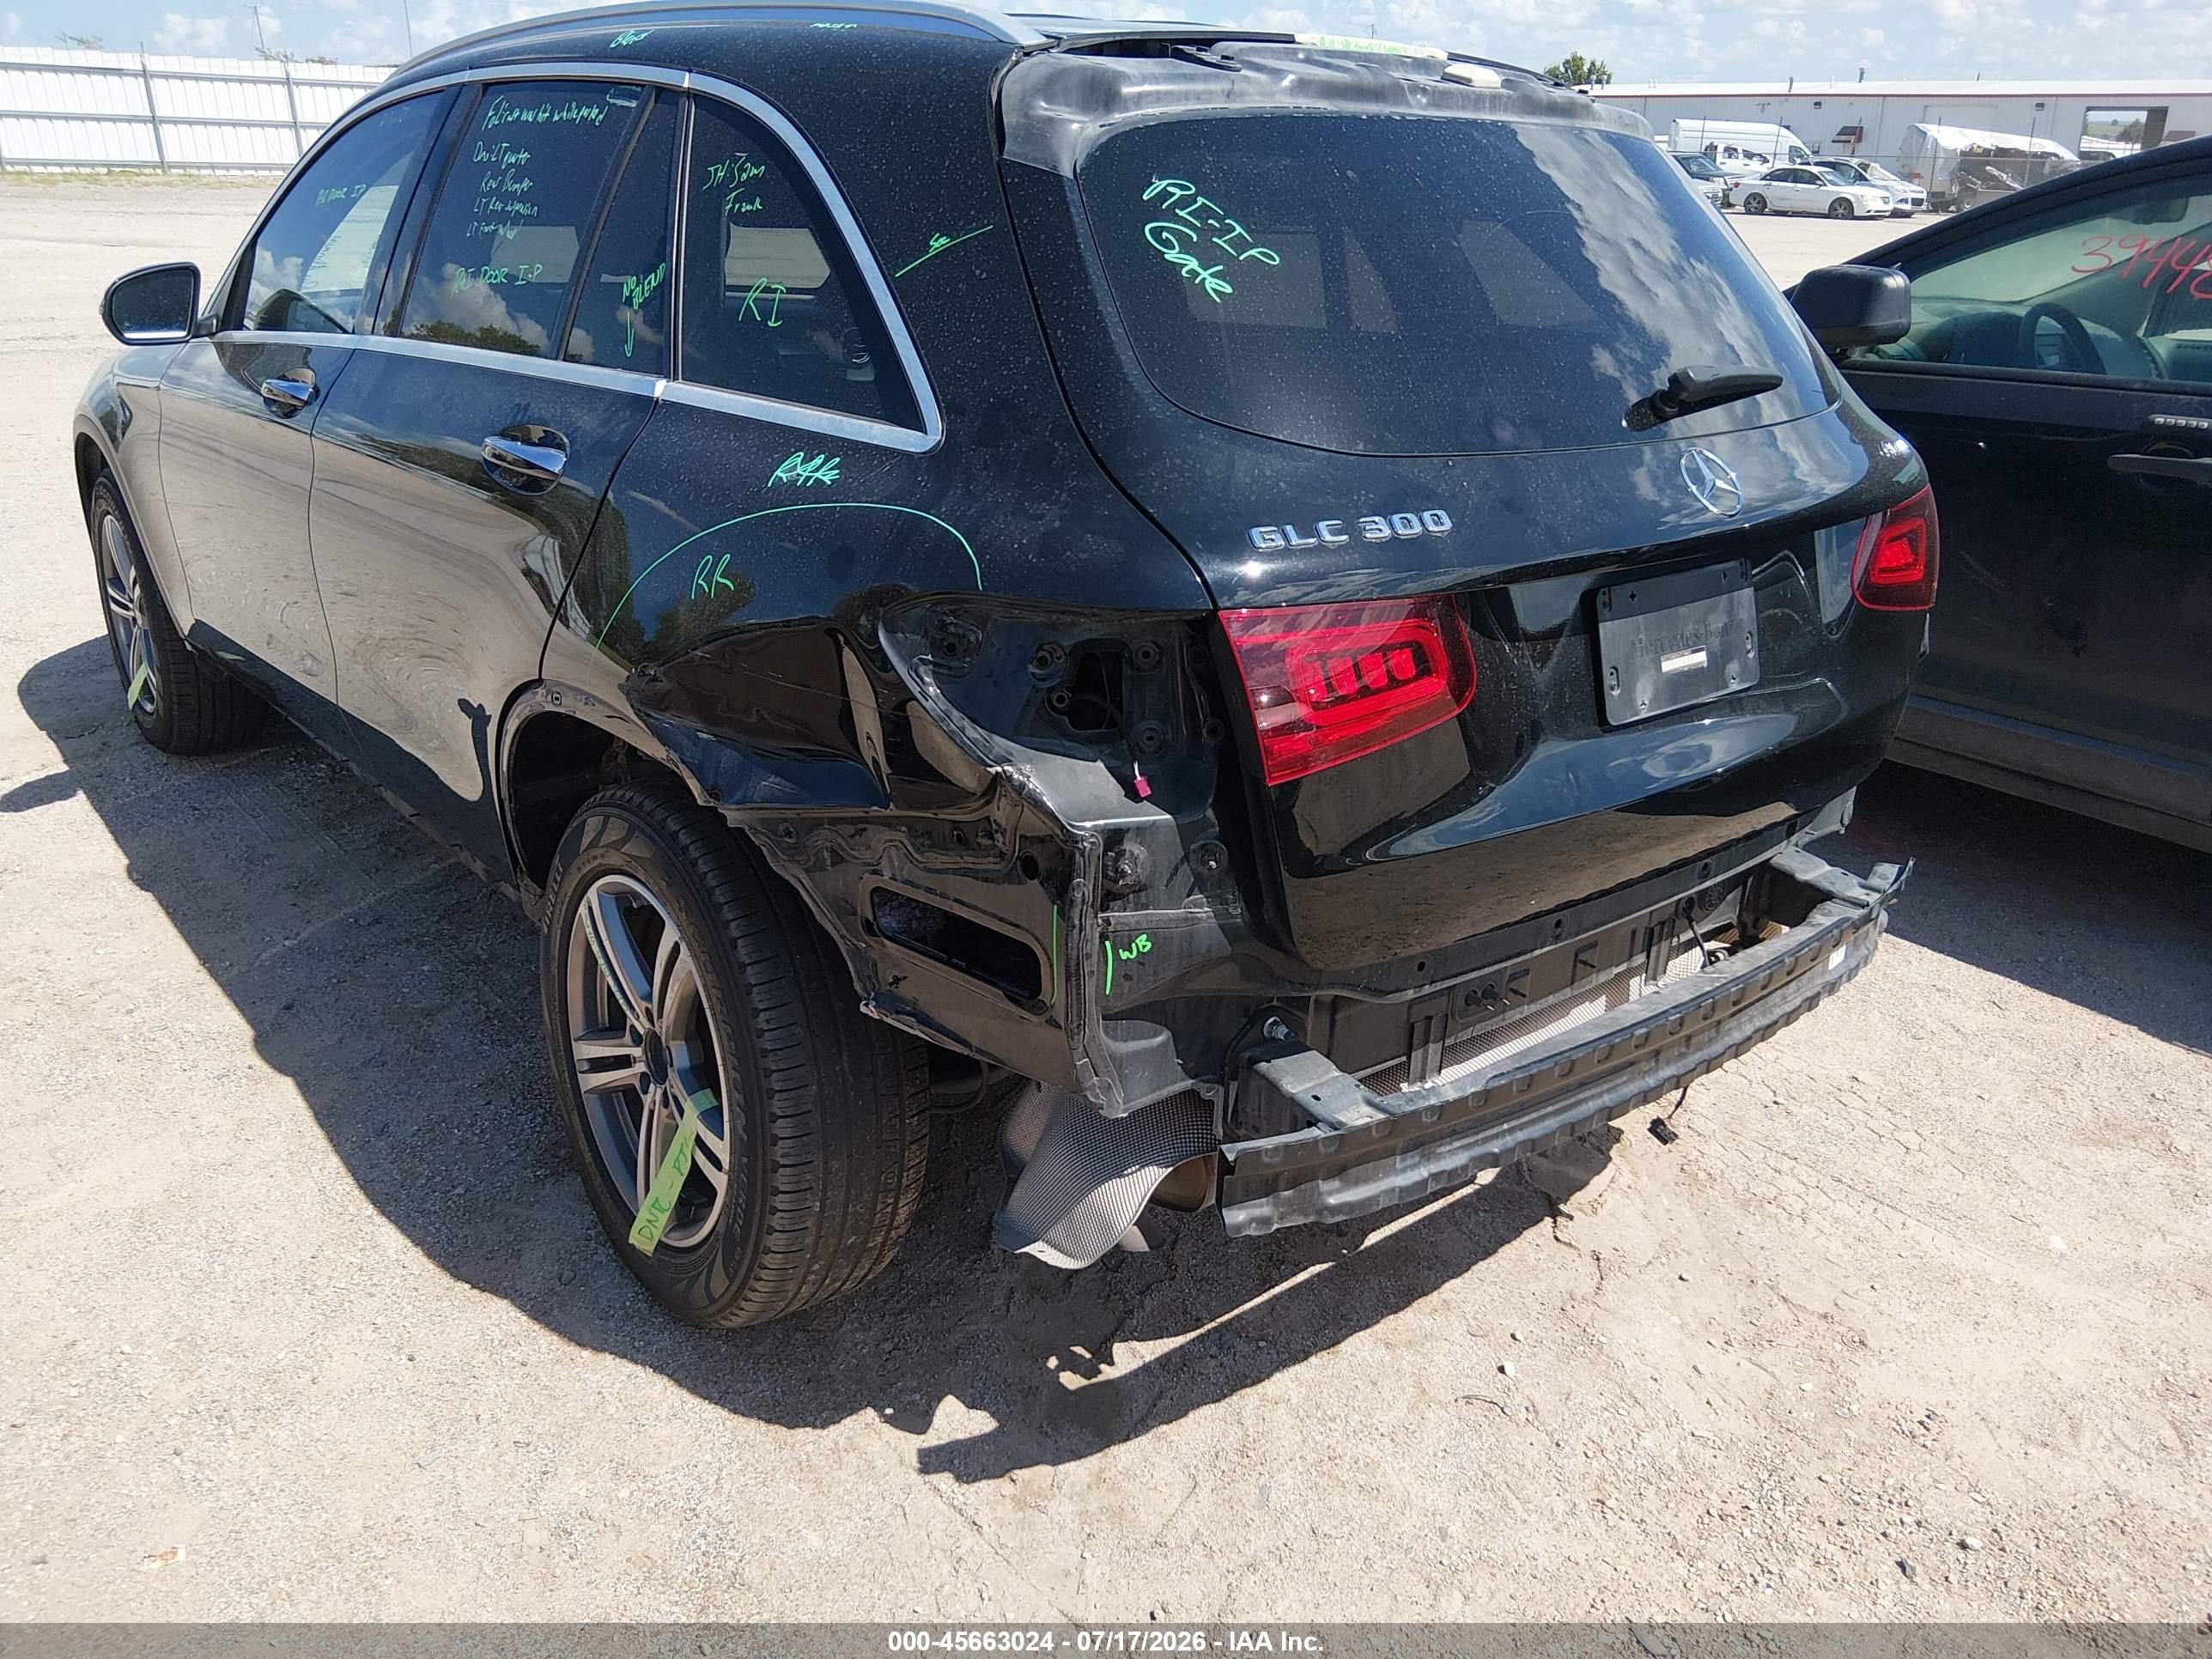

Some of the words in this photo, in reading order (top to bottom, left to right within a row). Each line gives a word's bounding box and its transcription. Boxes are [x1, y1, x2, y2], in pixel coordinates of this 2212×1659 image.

[1249, 520, 1350, 550] GLC
[1356, 509, 1453, 541] 300
[1119, 933, 1152, 960] WB
